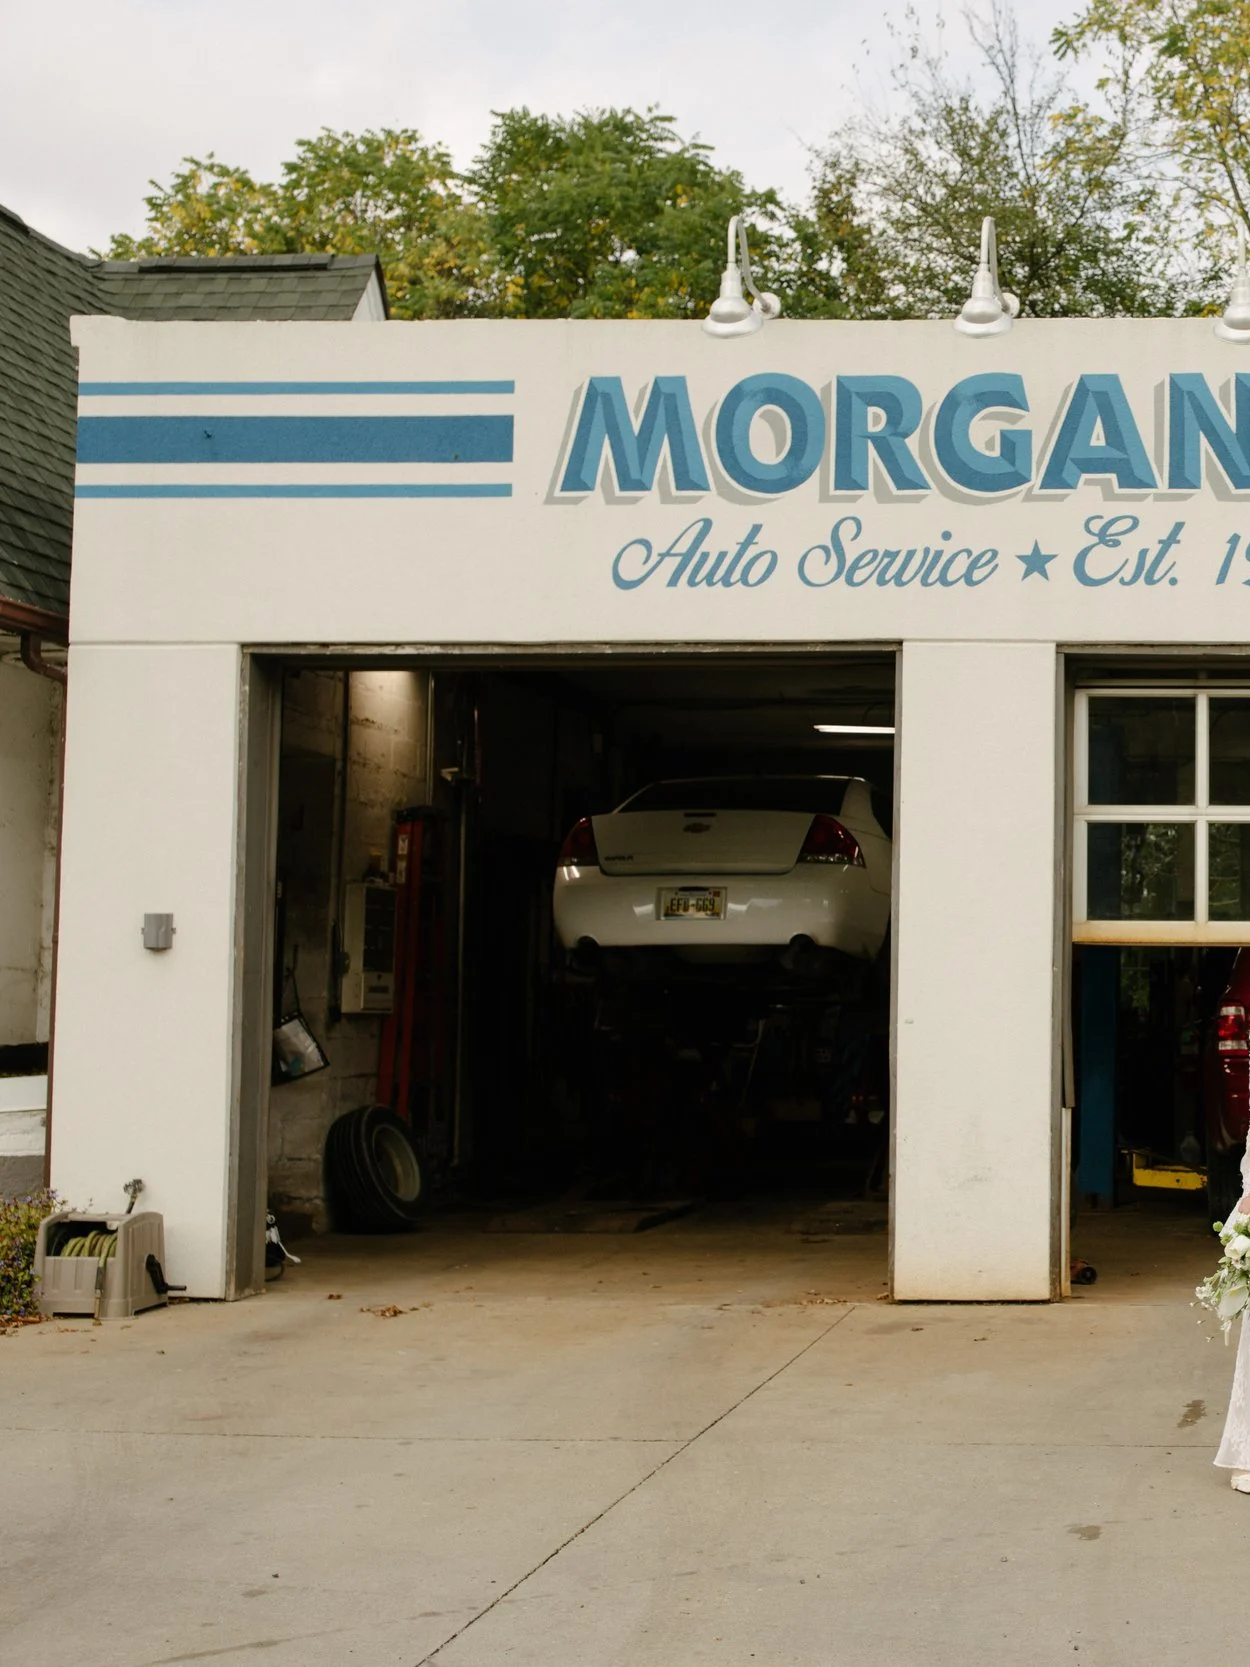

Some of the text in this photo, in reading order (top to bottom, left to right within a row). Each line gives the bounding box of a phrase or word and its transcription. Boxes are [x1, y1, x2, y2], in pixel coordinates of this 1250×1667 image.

[611, 517, 779, 591] Auto
[797, 515, 1000, 588] Service
[1072, 514, 1187, 588] Est.
